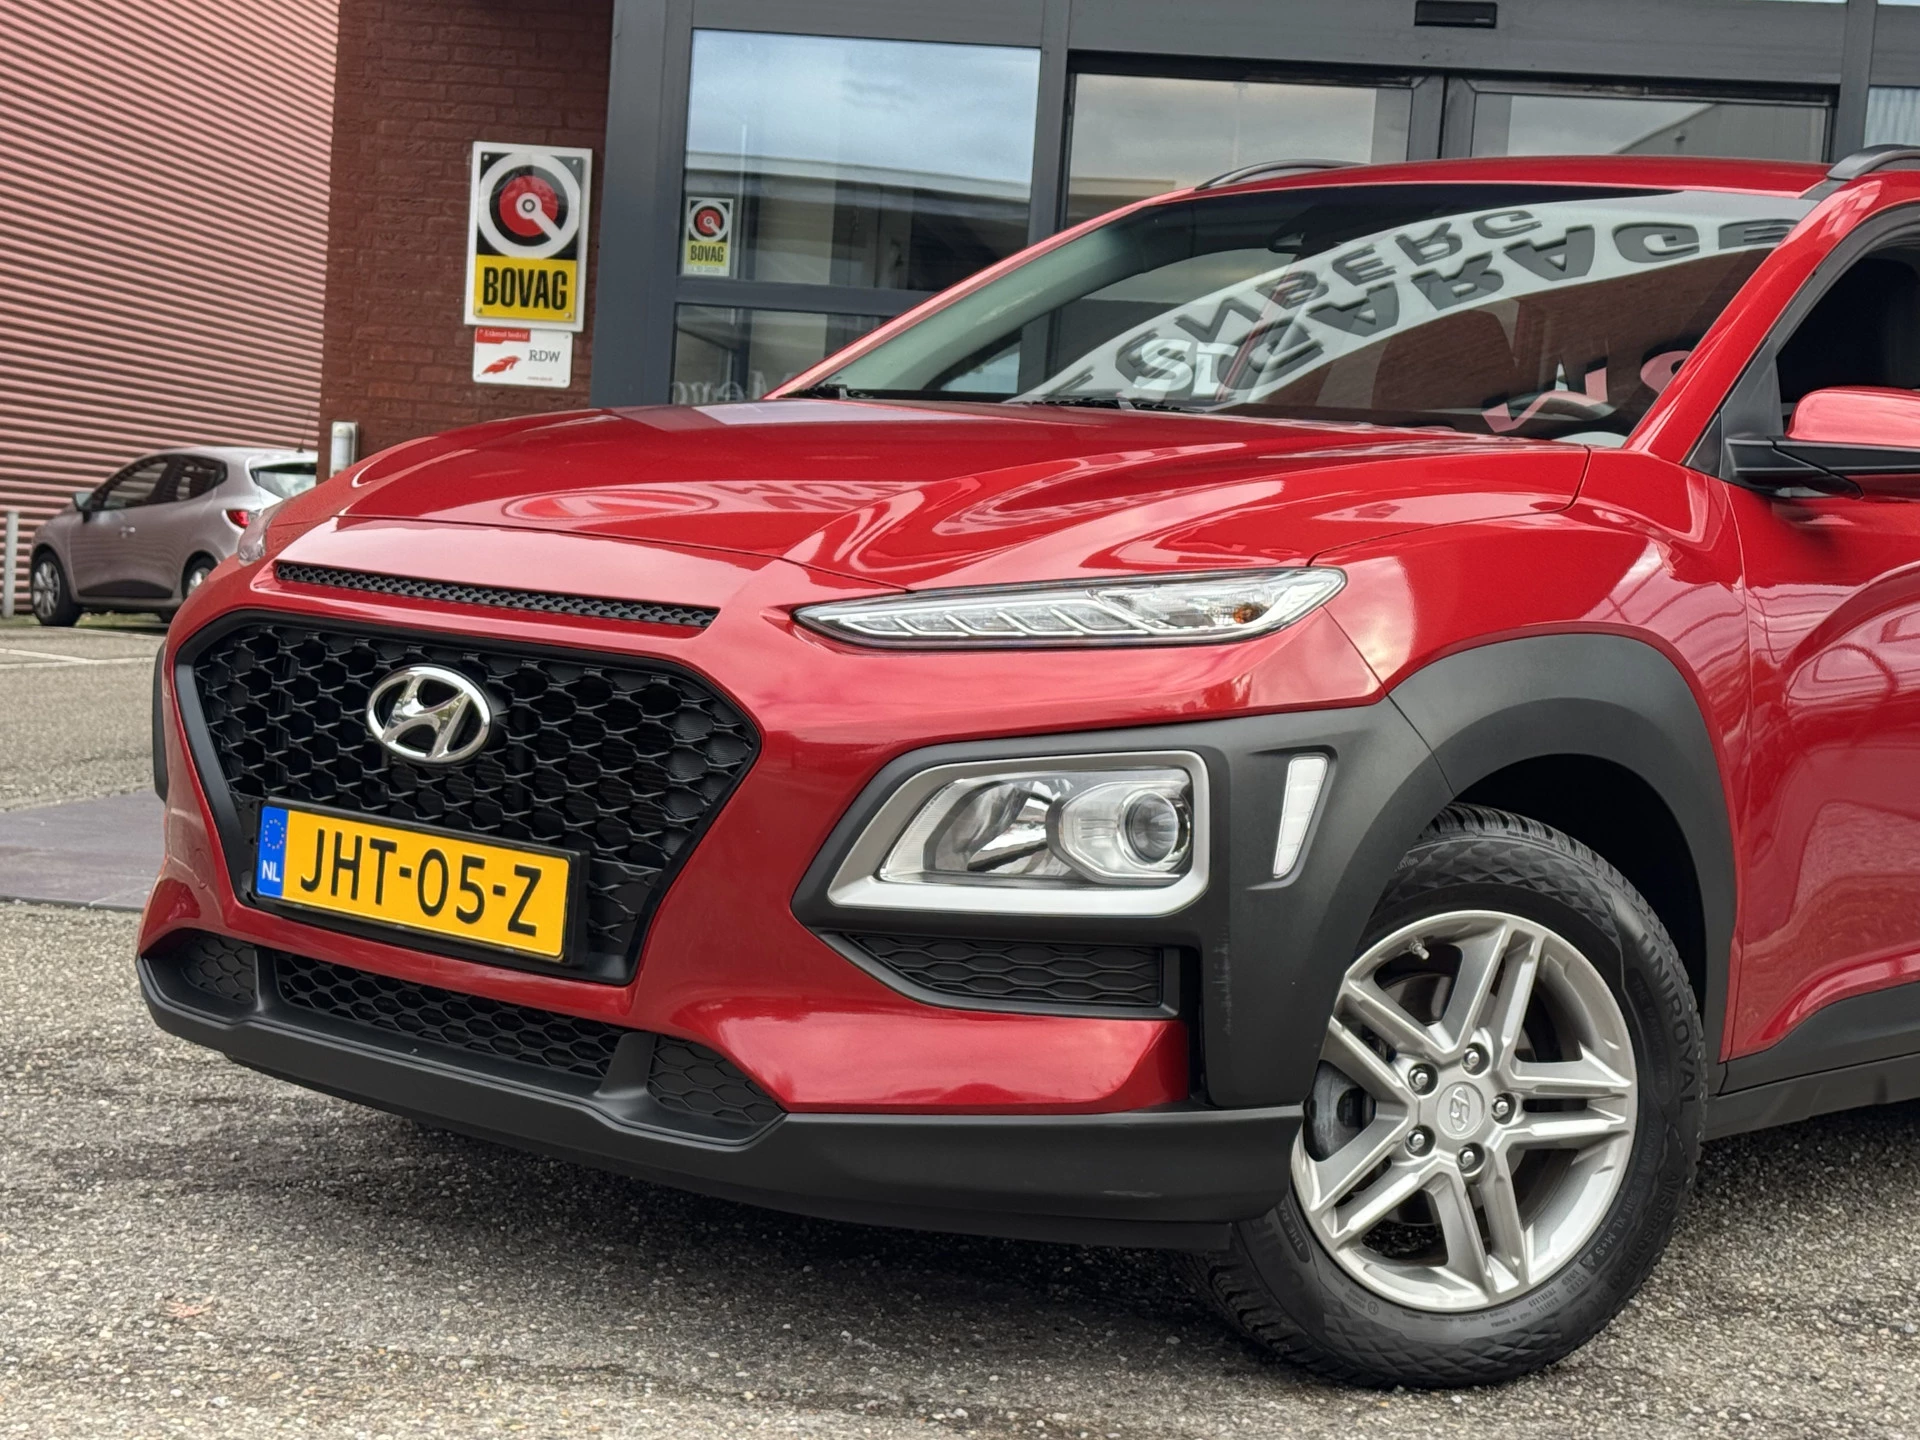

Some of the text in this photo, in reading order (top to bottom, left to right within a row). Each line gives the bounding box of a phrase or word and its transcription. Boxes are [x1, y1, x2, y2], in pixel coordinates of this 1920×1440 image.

[690, 245, 725, 262] BOVAG
[483, 266, 568, 311] BOVAG
[528, 349, 561, 363] RDW
[262, 859, 281, 883] NL
[300, 828, 542, 938] JHT-05-Z
[1636, 931, 1697, 1117] UNIROYAL
